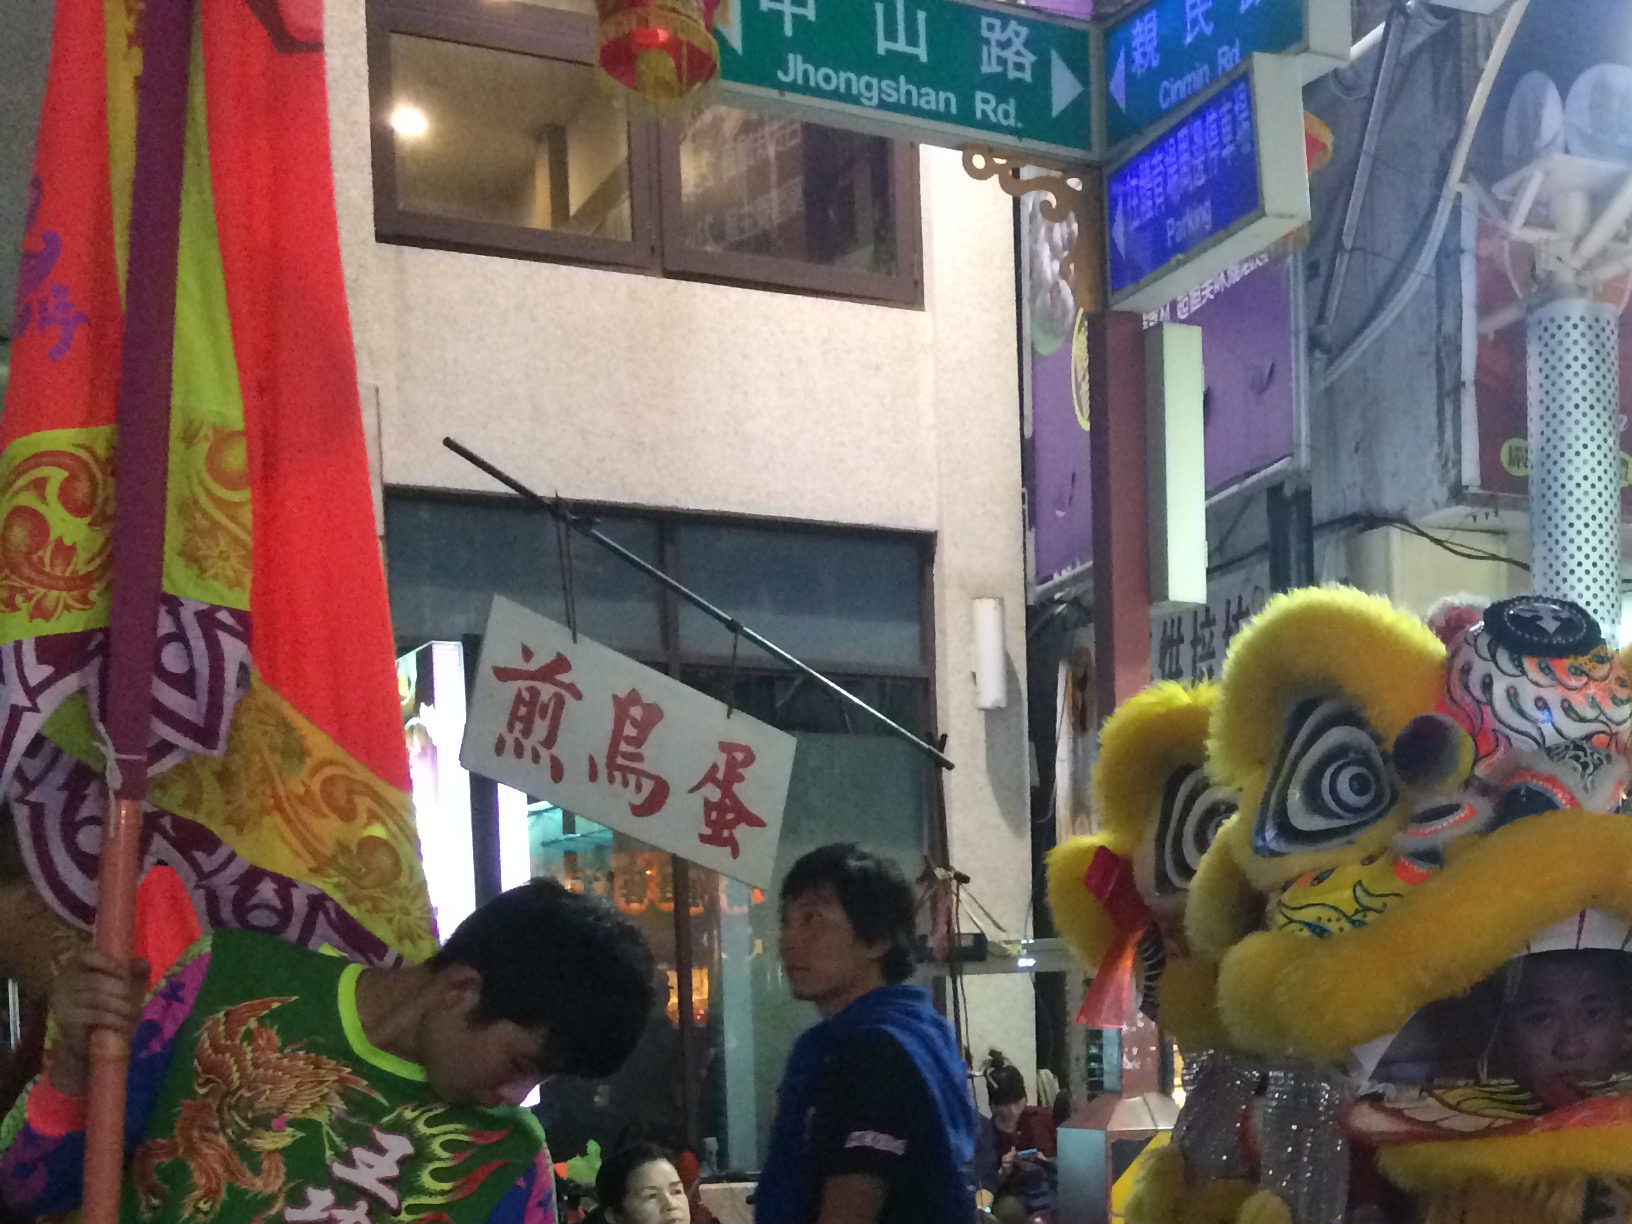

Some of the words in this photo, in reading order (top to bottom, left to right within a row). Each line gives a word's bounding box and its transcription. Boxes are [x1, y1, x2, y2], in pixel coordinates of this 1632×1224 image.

[1131, 0, 1261, 78] 親民
[777, 53, 957, 115] Jhongshan
[975, 91, 1024, 128] Rd.
[1166, 199, 1213, 248] Parking
[491, 642, 768, 860] 煎鳥蛋
